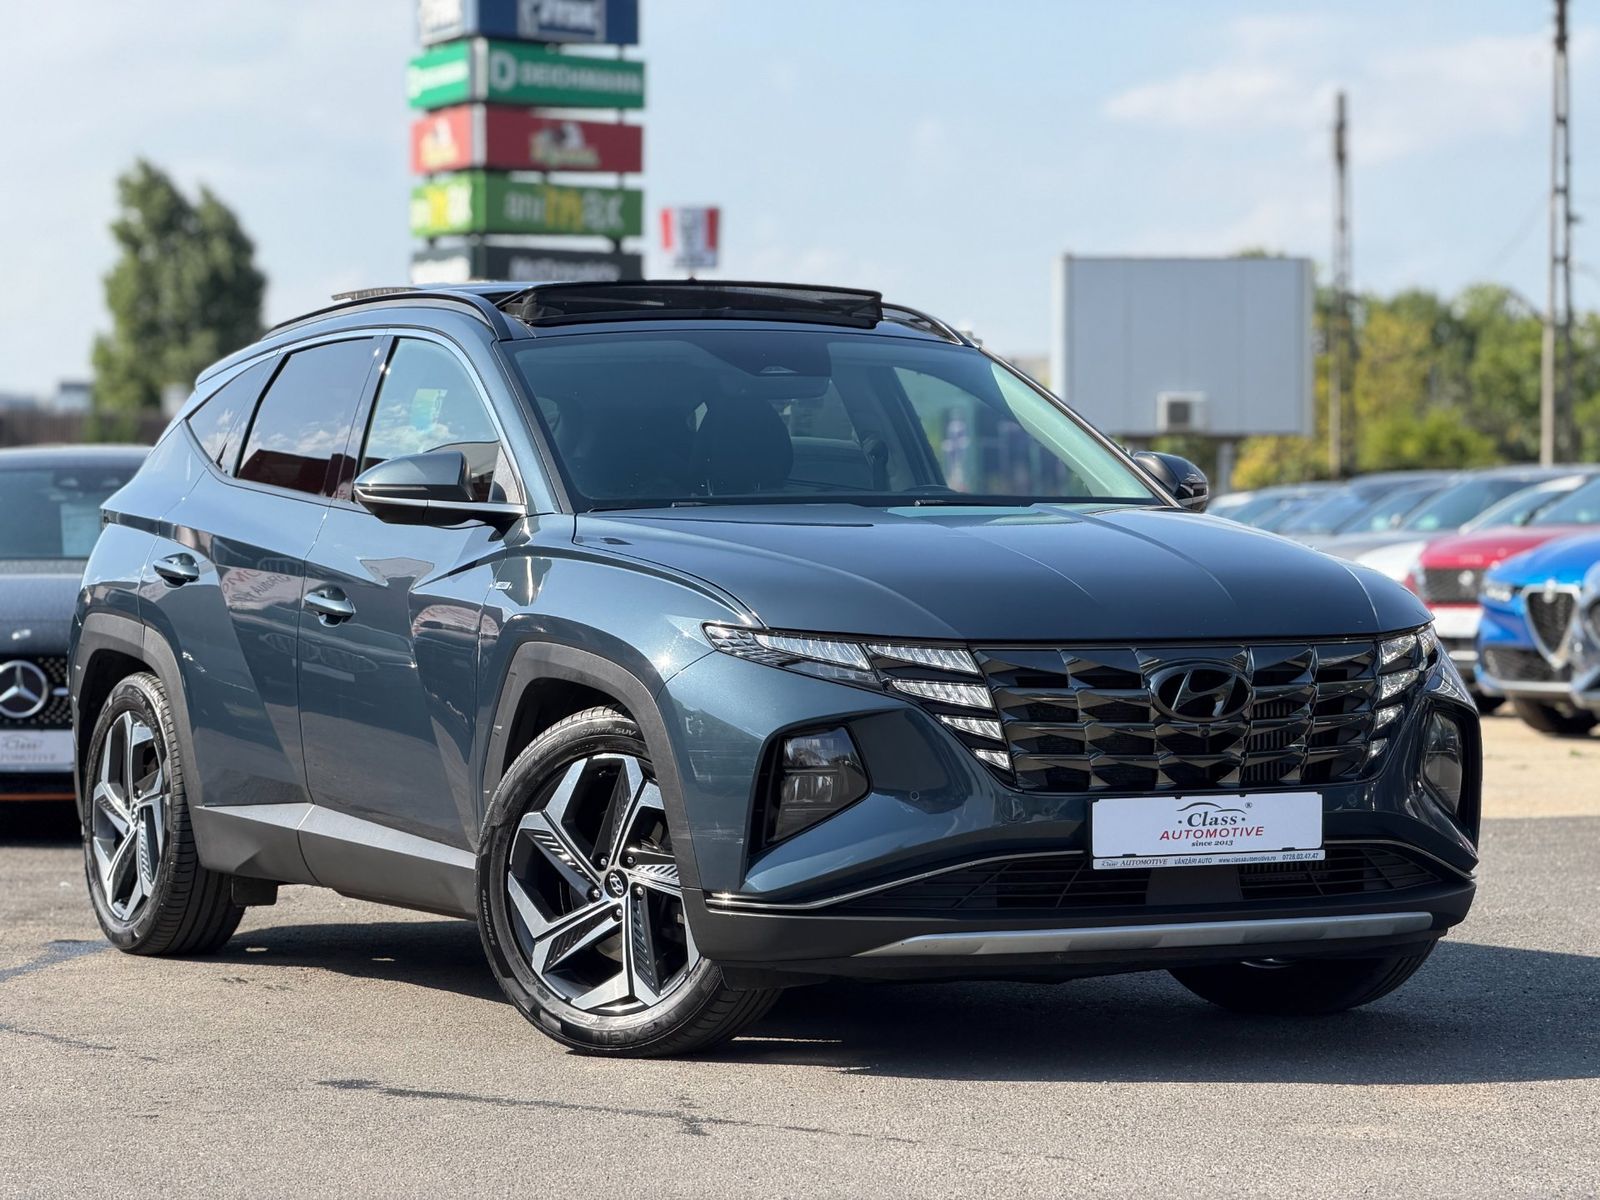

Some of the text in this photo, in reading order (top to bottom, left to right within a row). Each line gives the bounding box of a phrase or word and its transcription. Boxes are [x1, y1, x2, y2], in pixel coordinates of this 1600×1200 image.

[1187, 811, 1238, 827] Class
[1159, 826, 1265, 841] AUTOMOTIVE
[1121, 858, 1169, 867] AUTOMOTIVE
[1198, 857, 1213, 865] AUTO
